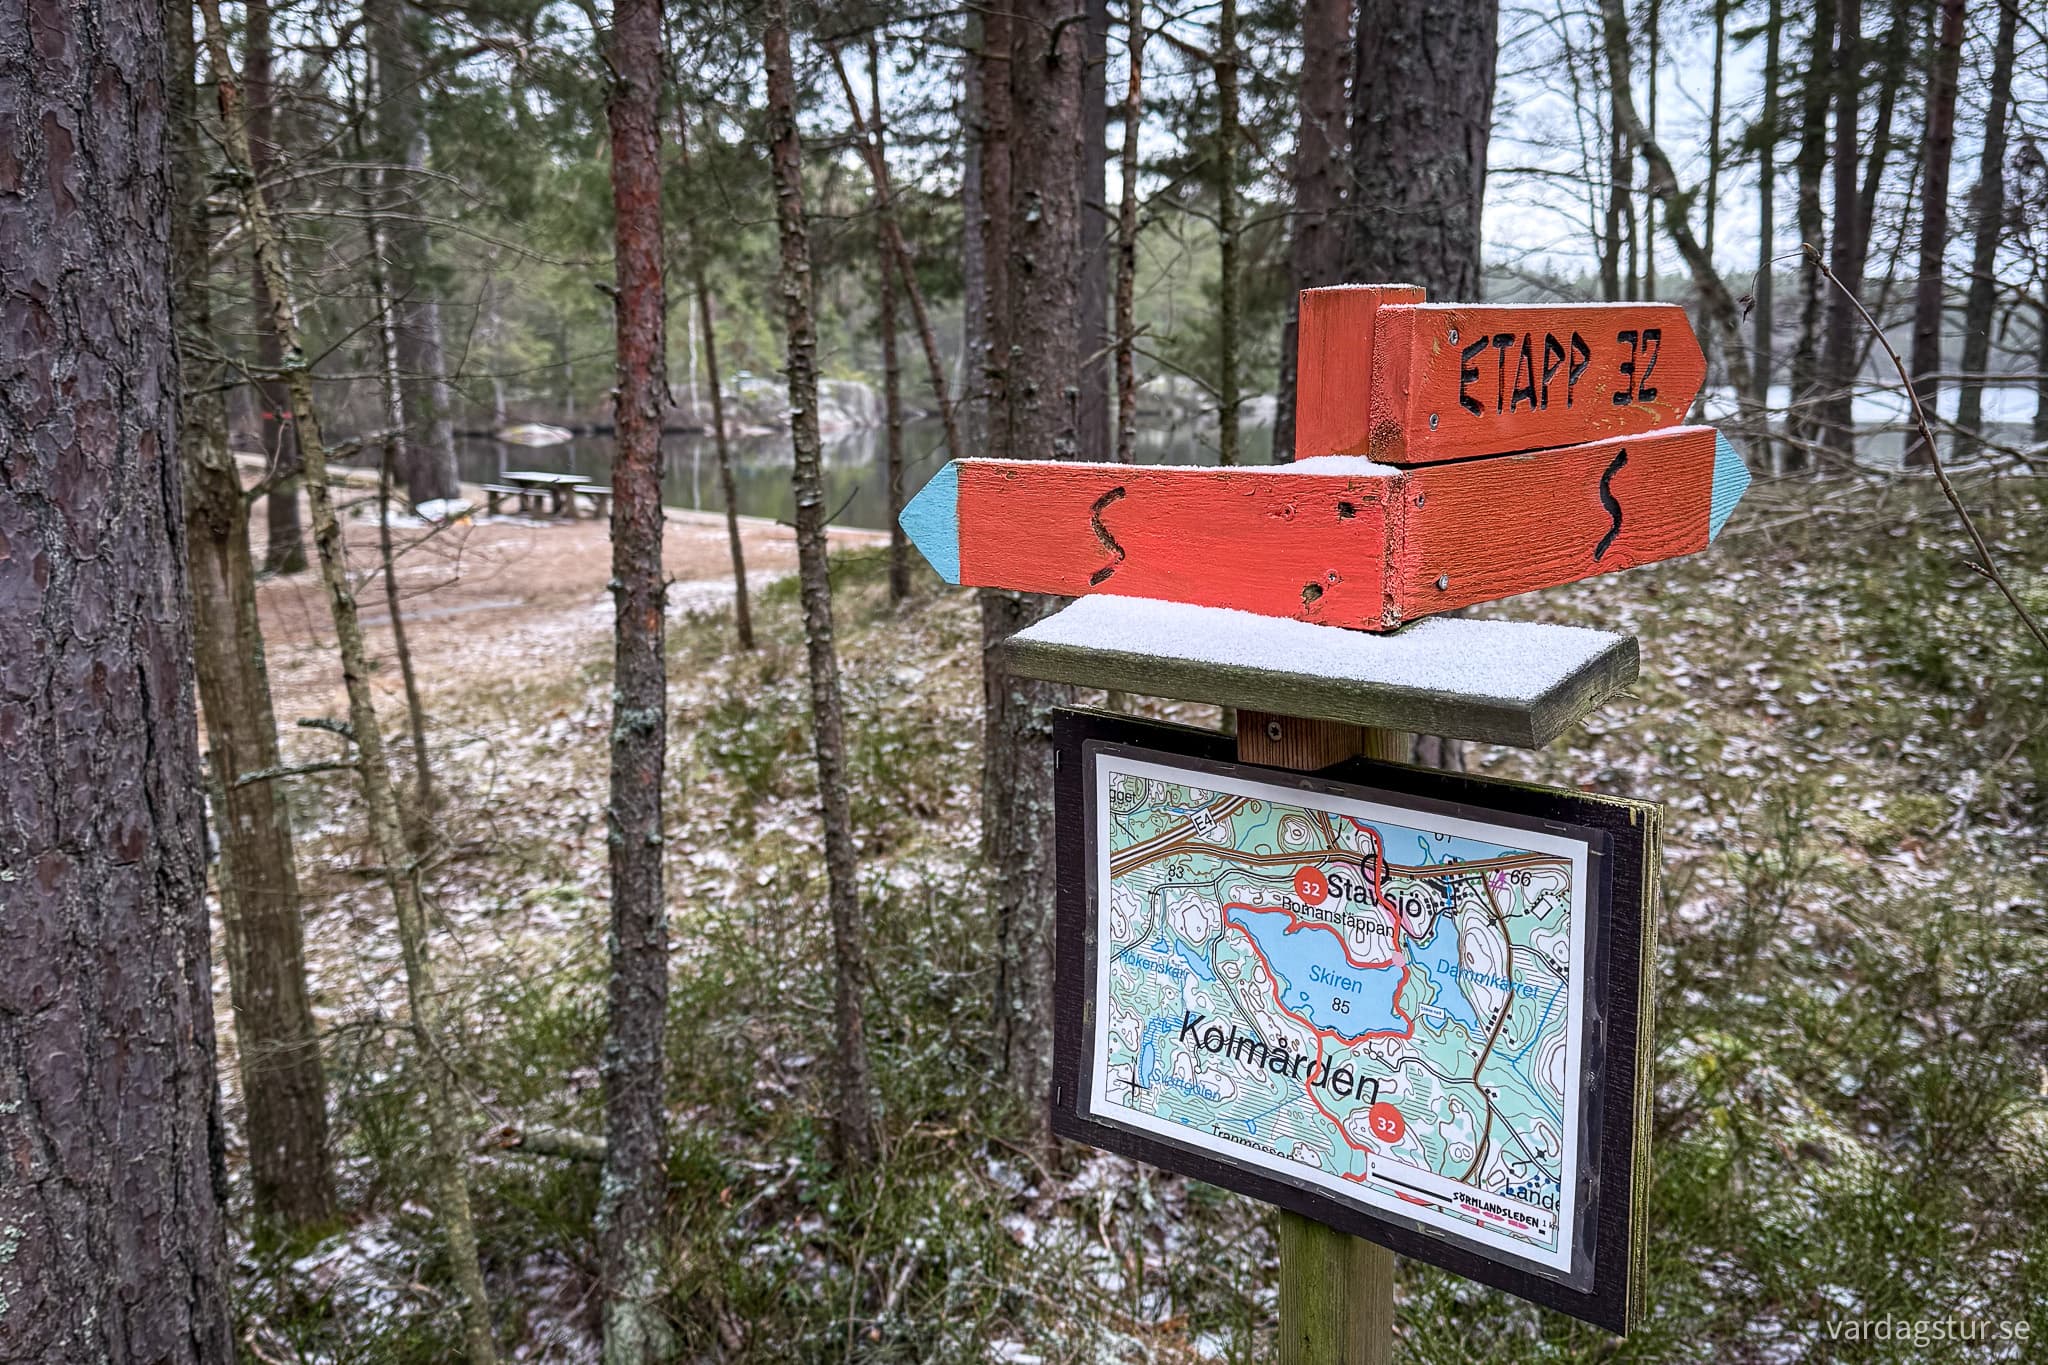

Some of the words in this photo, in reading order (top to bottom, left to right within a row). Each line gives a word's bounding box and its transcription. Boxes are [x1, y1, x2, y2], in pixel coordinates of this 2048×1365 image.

[1459, 331, 1591, 417] ETAPP
[1613, 328, 1662, 405] 32
[1195, 813, 1213, 831] E4
[1168, 865, 1184, 879] 83
[1510, 869, 1532, 888] 66
[1302, 881, 1321, 897] 32
[1327, 873, 1422, 919] Stavsjö
[1282, 895, 1395, 938] Bomanstäppan
[1309, 964, 1363, 994] Skiren
[1331, 997, 1351, 1014] 85
[1179, 1010, 1379, 1105] Kolmården
[1377, 1117, 1397, 1134] 32
[1453, 1192, 1539, 1228] SÖRMLANDSLEDEN
